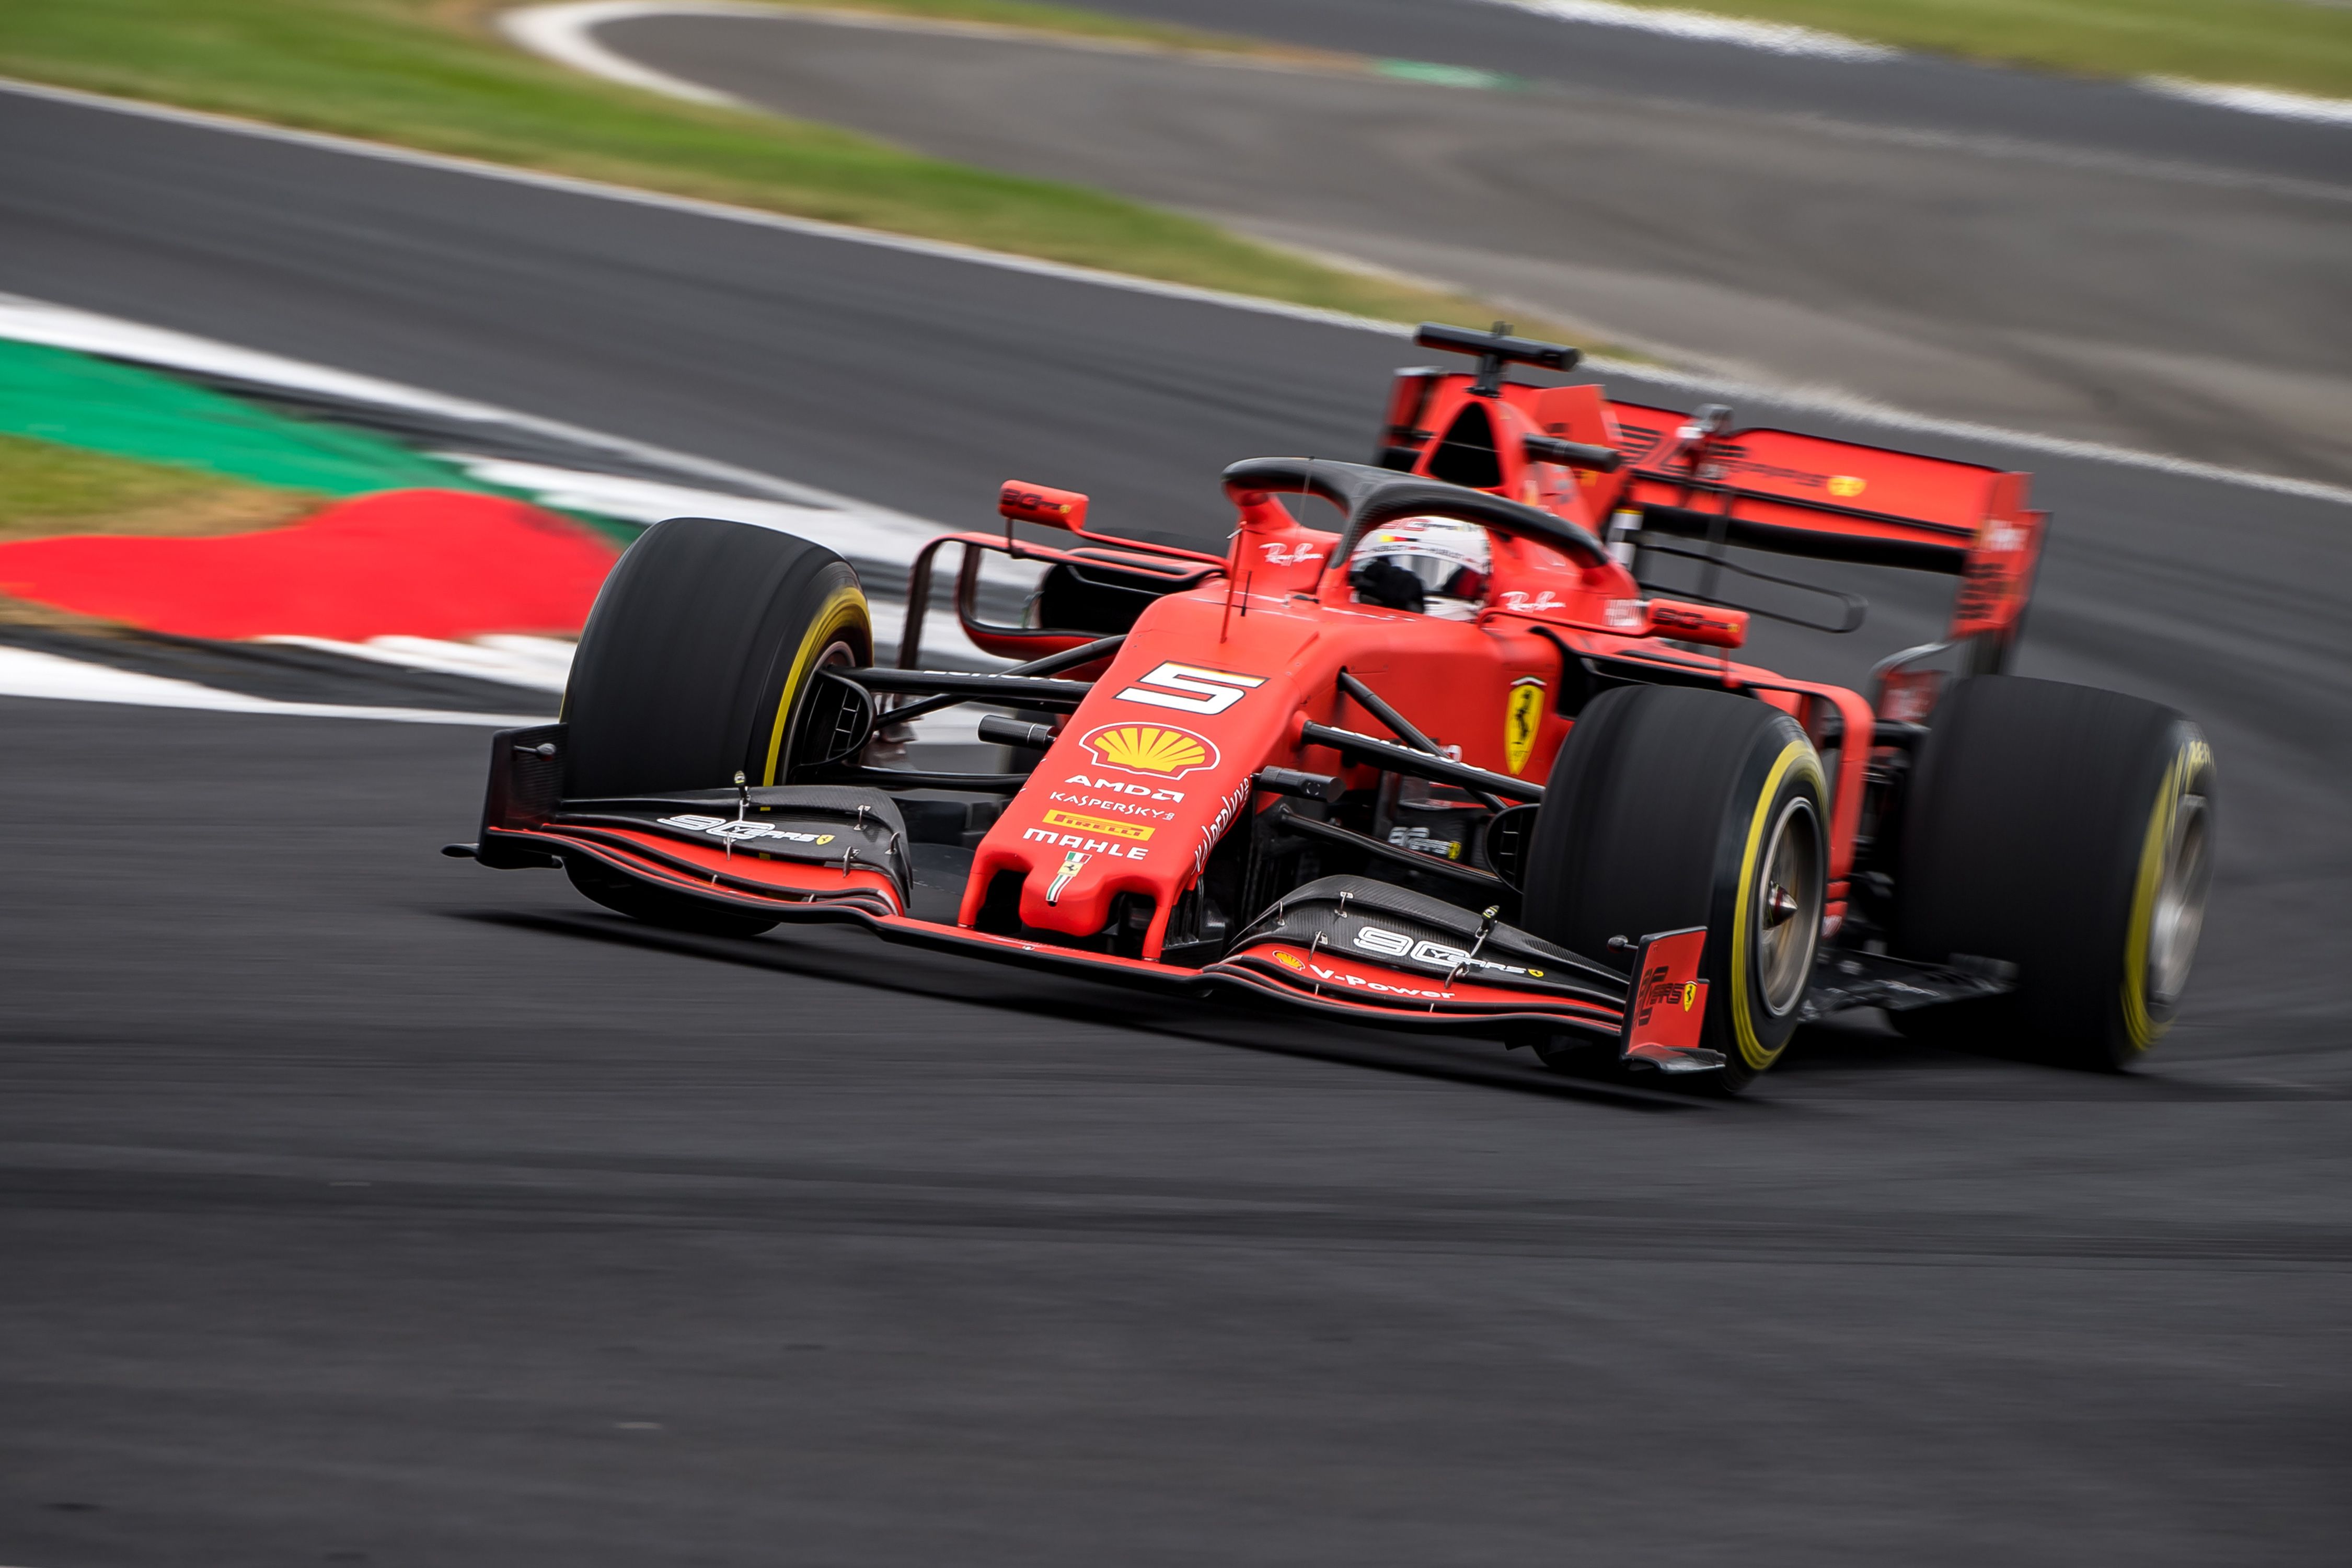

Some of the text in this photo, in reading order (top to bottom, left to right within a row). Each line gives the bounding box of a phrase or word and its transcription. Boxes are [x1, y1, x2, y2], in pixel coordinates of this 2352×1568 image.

[1113, 661, 1270, 714] 5
[1064, 775, 1151, 796] AMD
[1050, 791, 1165, 818] KASPERSKY
[1054, 814, 1144, 837] PIRELLI
[1022, 828, 1149, 860] MAHLE
[1353, 926, 1471, 968] 90
[1309, 964, 1455, 999] V-Power
